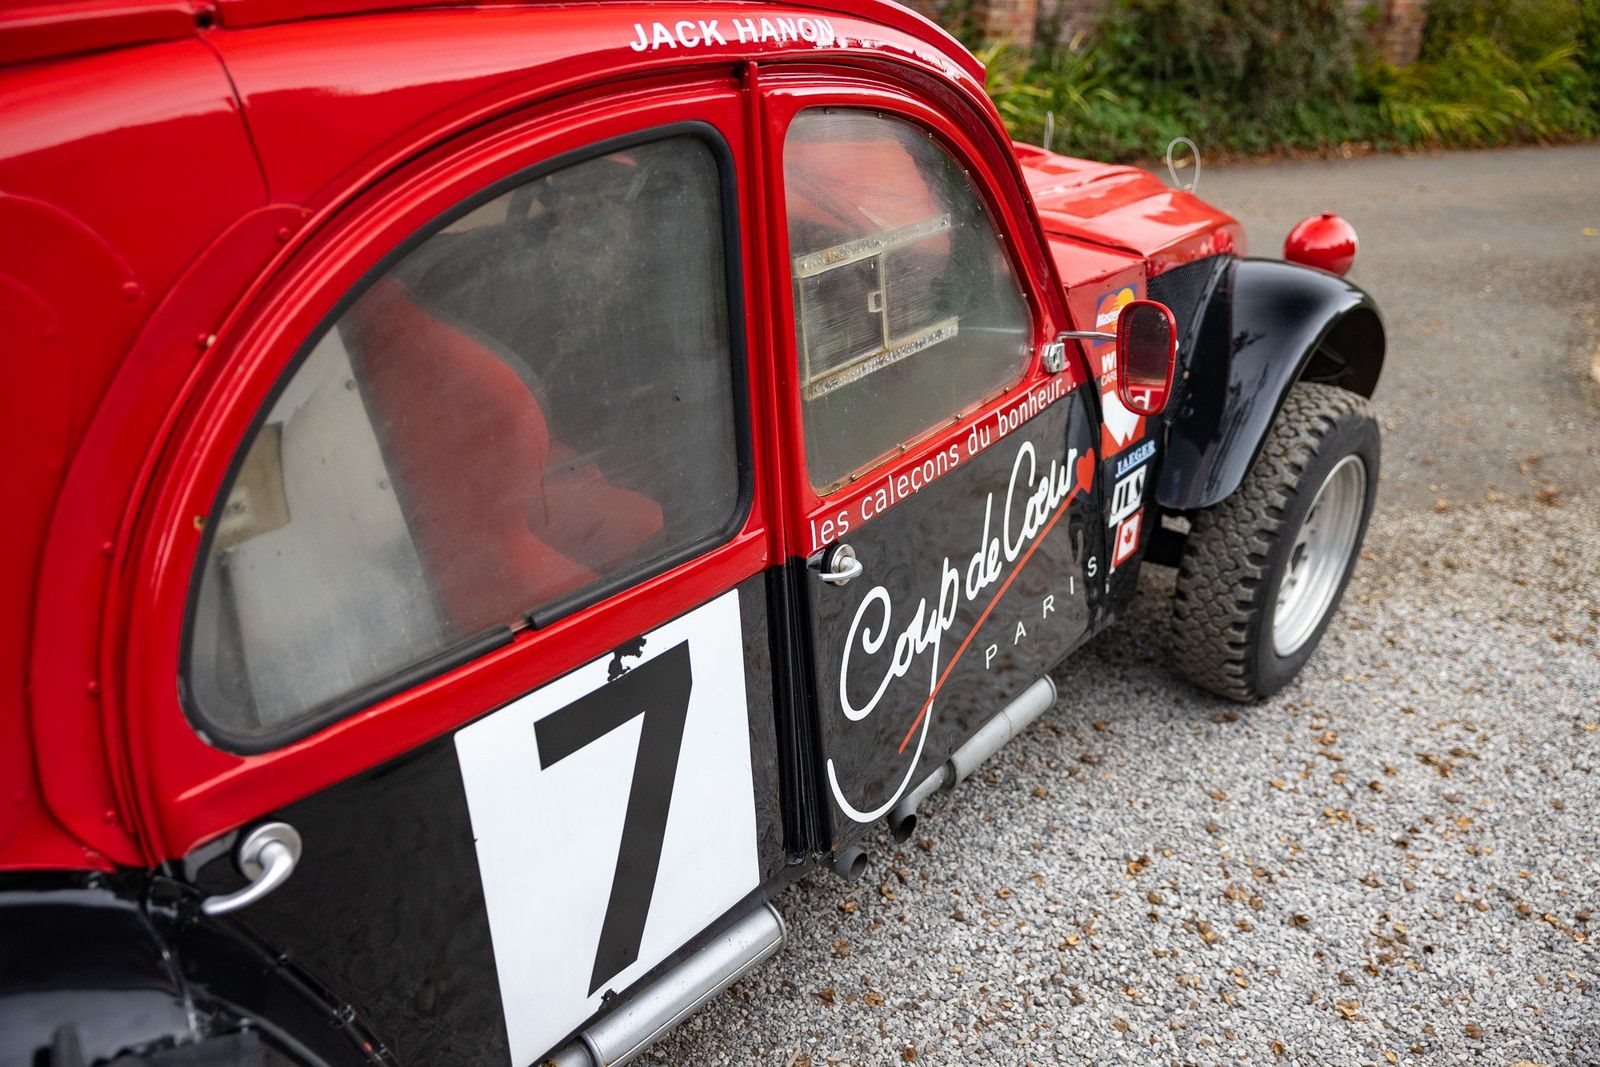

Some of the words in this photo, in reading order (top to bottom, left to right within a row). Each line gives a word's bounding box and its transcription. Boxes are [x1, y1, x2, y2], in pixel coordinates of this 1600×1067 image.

[630, 19, 727, 52] JACK
[732, 17, 836, 44] HANON
[809, 509, 849, 551] les
[860, 442, 960, 521] caleçons
[967, 424, 991, 456] du
[1115, 439, 1157, 479] JAEGER
[827, 557, 959, 823] Coup
[965, 491, 1002, 601] de
[985, 556, 1098, 671] PARIS
[533, 638, 693, 1000] 7
